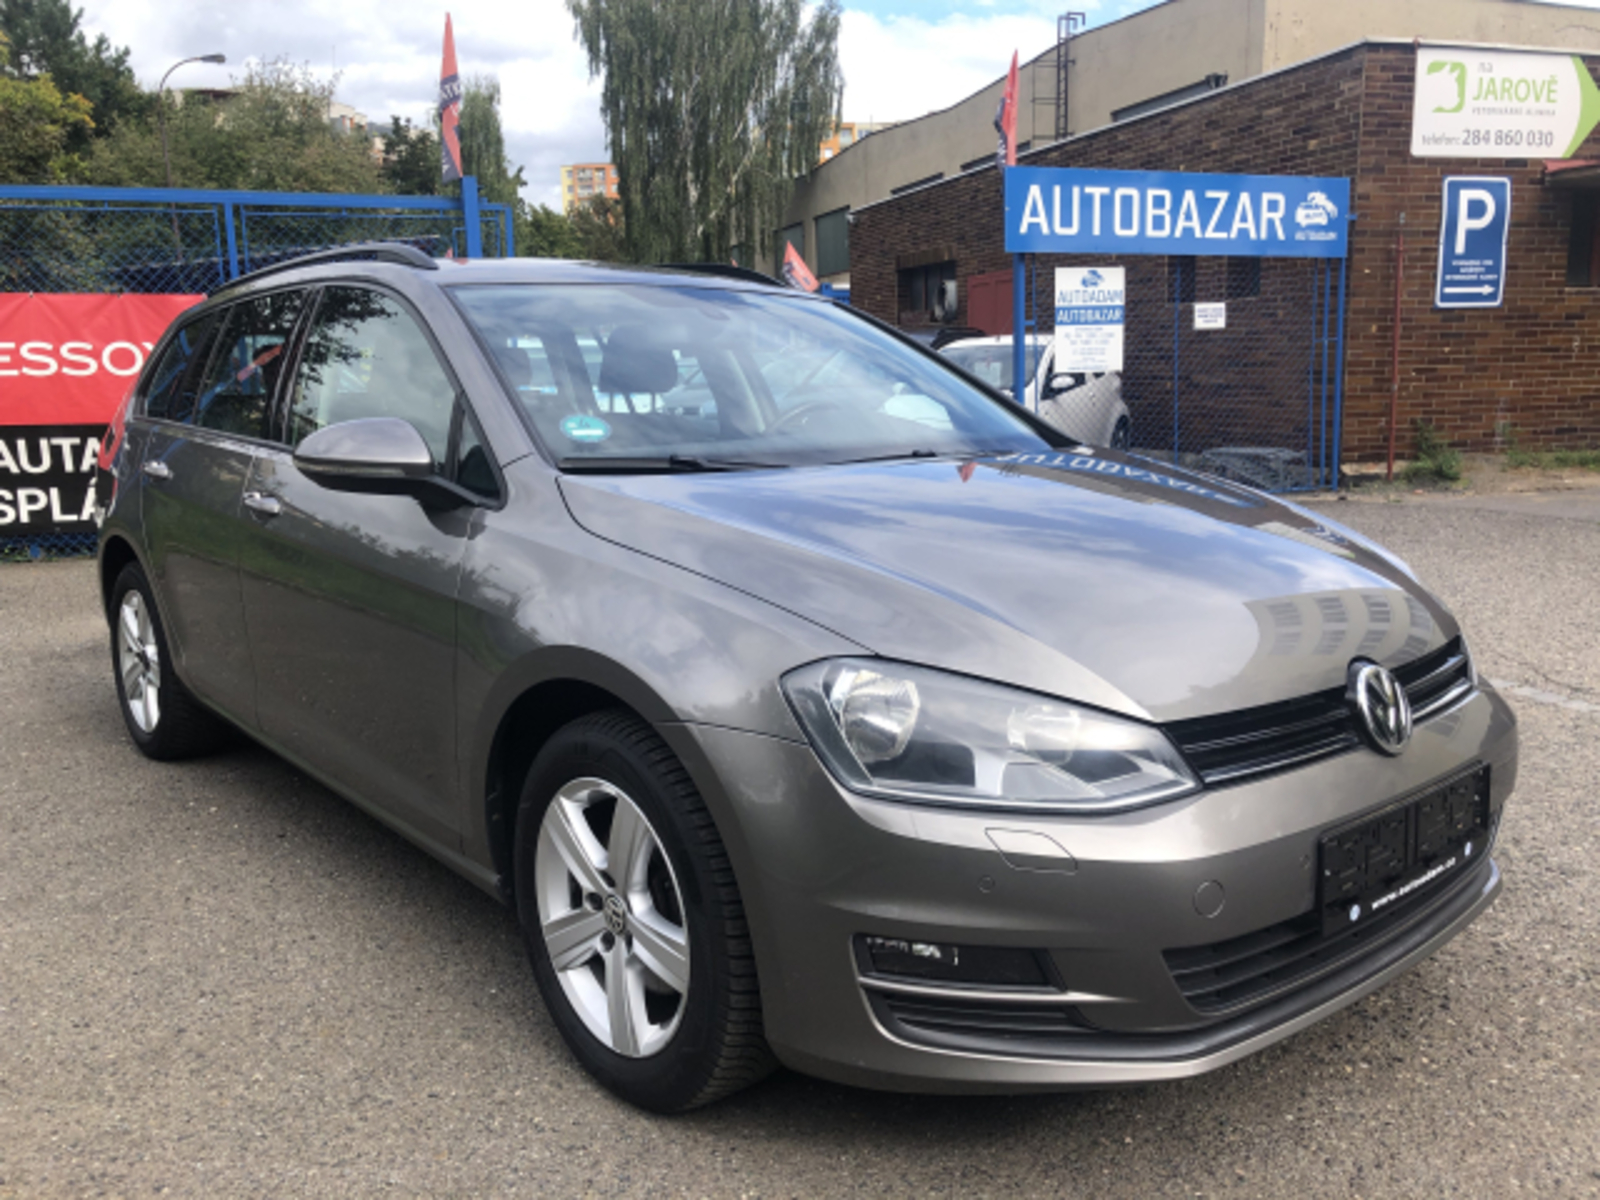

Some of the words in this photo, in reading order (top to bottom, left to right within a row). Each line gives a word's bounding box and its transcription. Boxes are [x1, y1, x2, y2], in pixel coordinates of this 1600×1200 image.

[1472, 75, 1558, 103] JAROVĚ
[1462, 129, 1491, 146] 284
[1494, 129, 1523, 146] 860
[1526, 130, 1554, 147] 030
[1019, 184, 1286, 241] AUTOBAZAR
[1455, 189, 1496, 255] P
[1057, 308, 1123, 323] AUTOBAZAR
